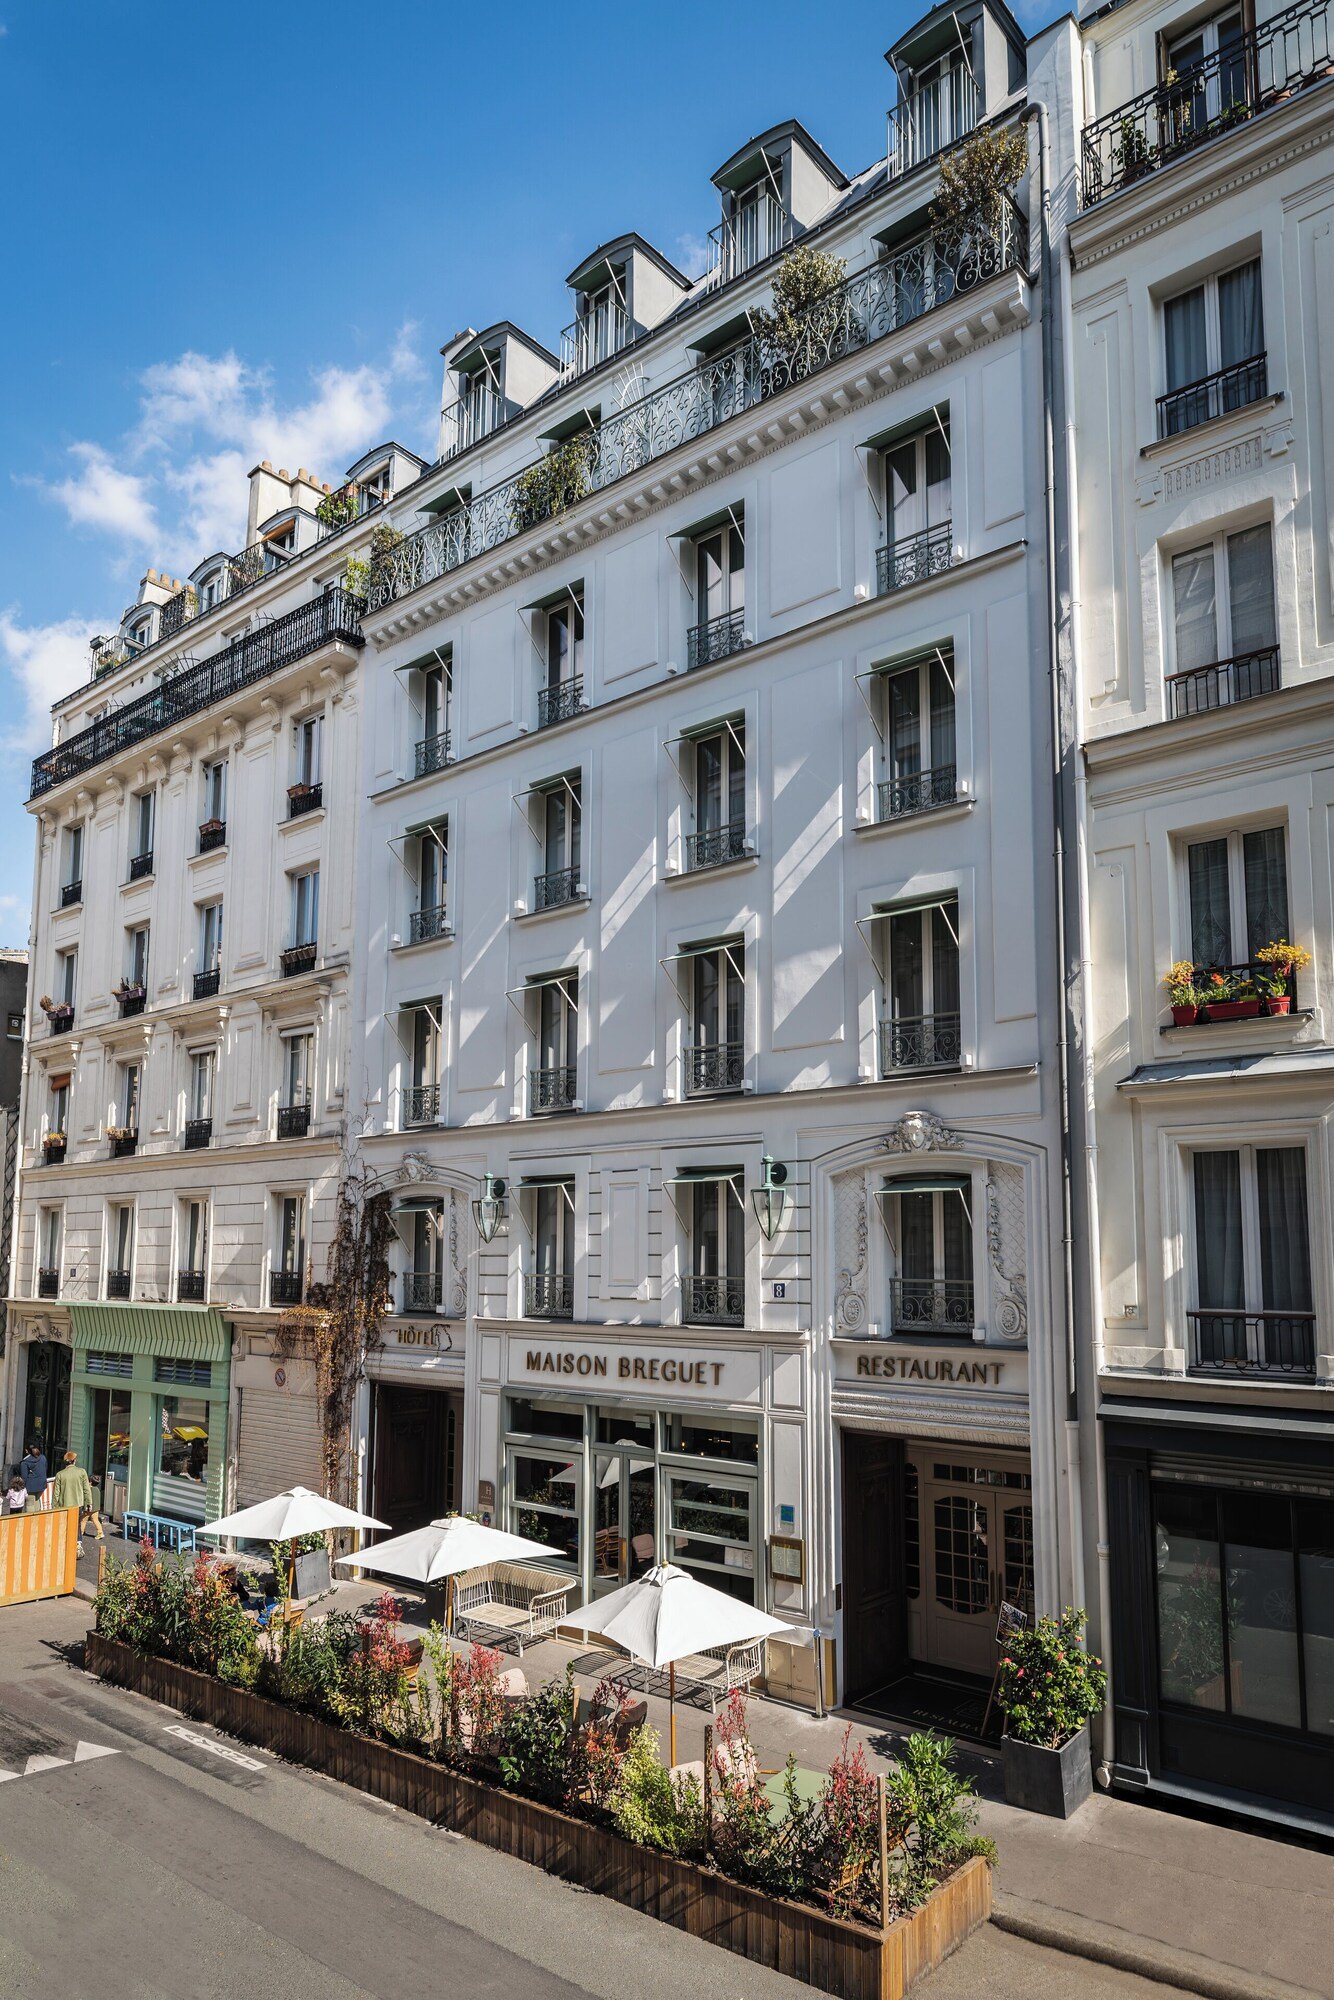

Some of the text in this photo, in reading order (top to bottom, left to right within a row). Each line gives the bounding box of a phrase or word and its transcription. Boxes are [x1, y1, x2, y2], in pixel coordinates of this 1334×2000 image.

[776, 1285, 782, 1297] 8
[398, 1325, 435, 1345] HÔTEL
[526, 1350, 725, 1386] MAISON BREGUET
[857, 1354, 1005, 1385] RESTAURANT
